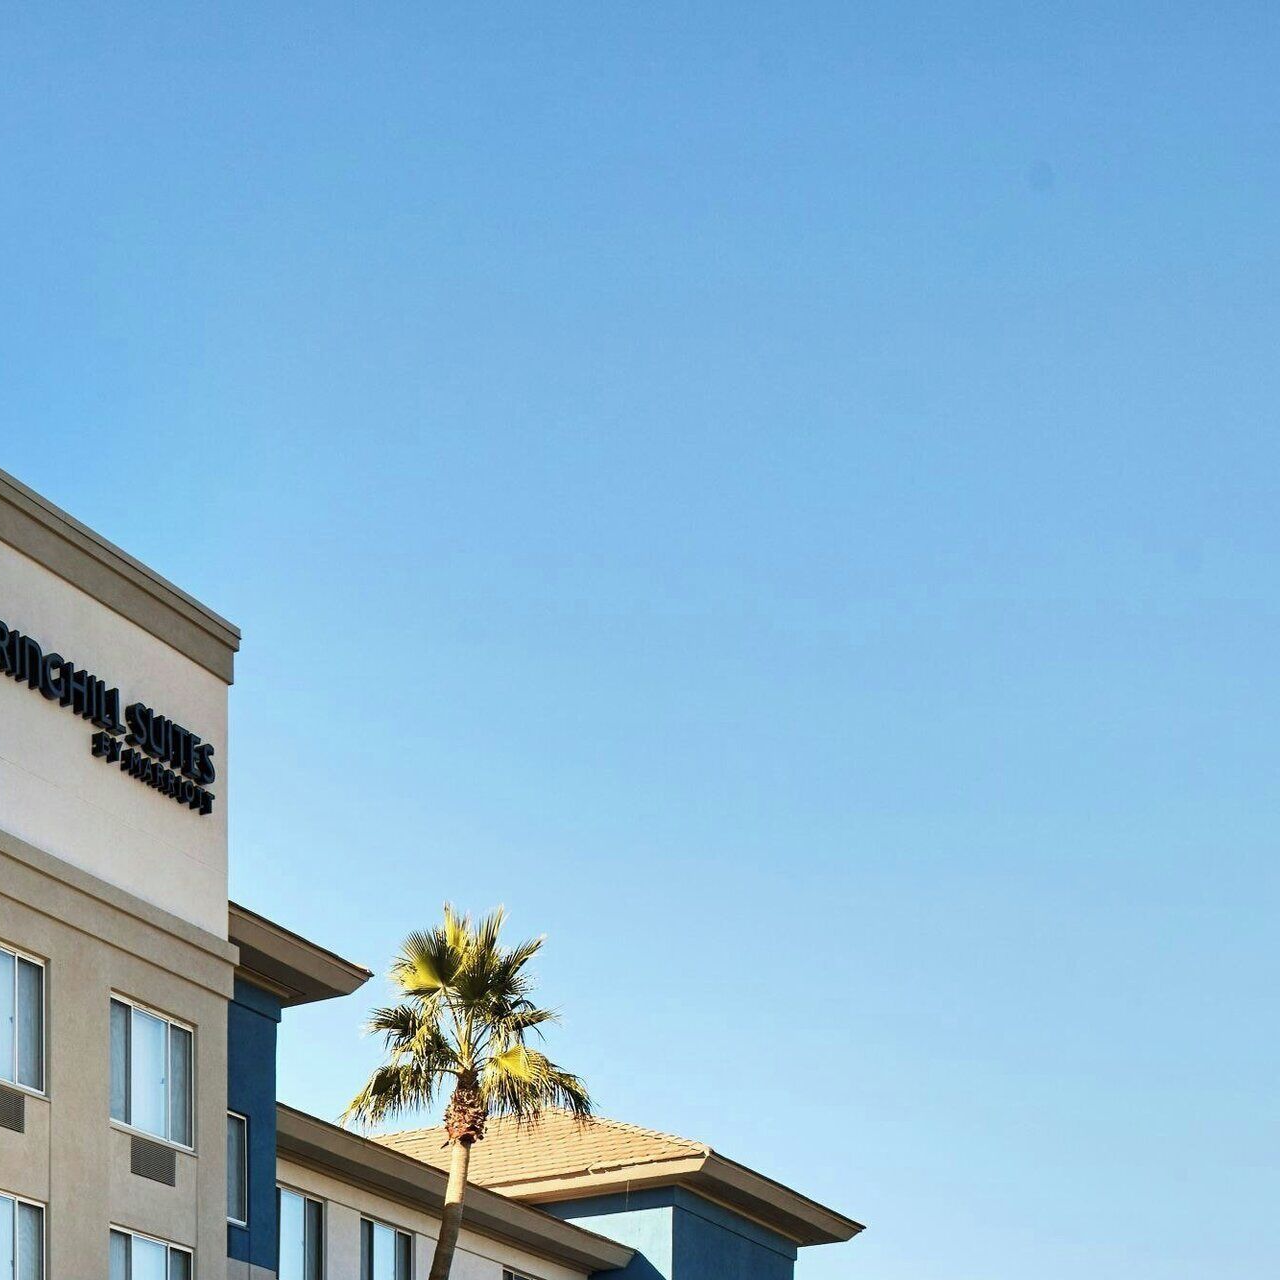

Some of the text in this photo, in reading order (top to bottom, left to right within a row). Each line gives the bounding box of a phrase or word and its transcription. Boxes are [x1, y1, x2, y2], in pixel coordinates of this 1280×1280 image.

[92, 731, 215, 815] BY MARRIOTT
[125, 702, 215, 784] SUITES
